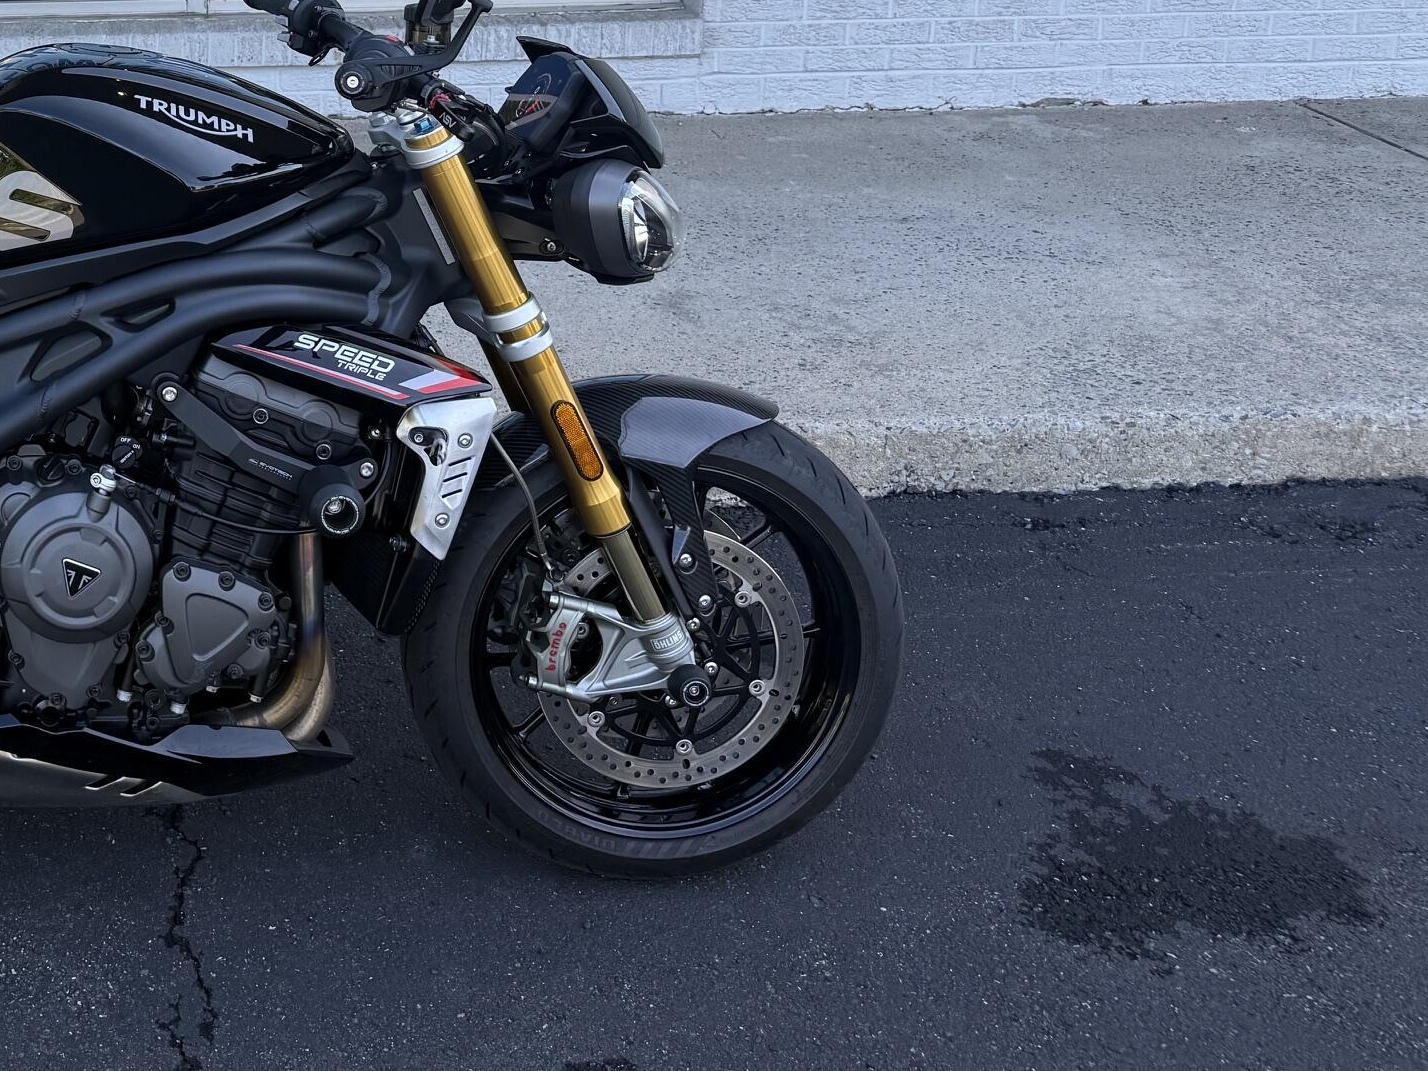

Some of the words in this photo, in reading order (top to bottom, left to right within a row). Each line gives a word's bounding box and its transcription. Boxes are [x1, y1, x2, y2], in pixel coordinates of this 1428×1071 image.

[134, 94, 254, 143] TRIUMPH
[293, 334, 395, 373] SPEED
[337, 359, 387, 381] TRIPLE
[545, 622, 567, 672] brembo
